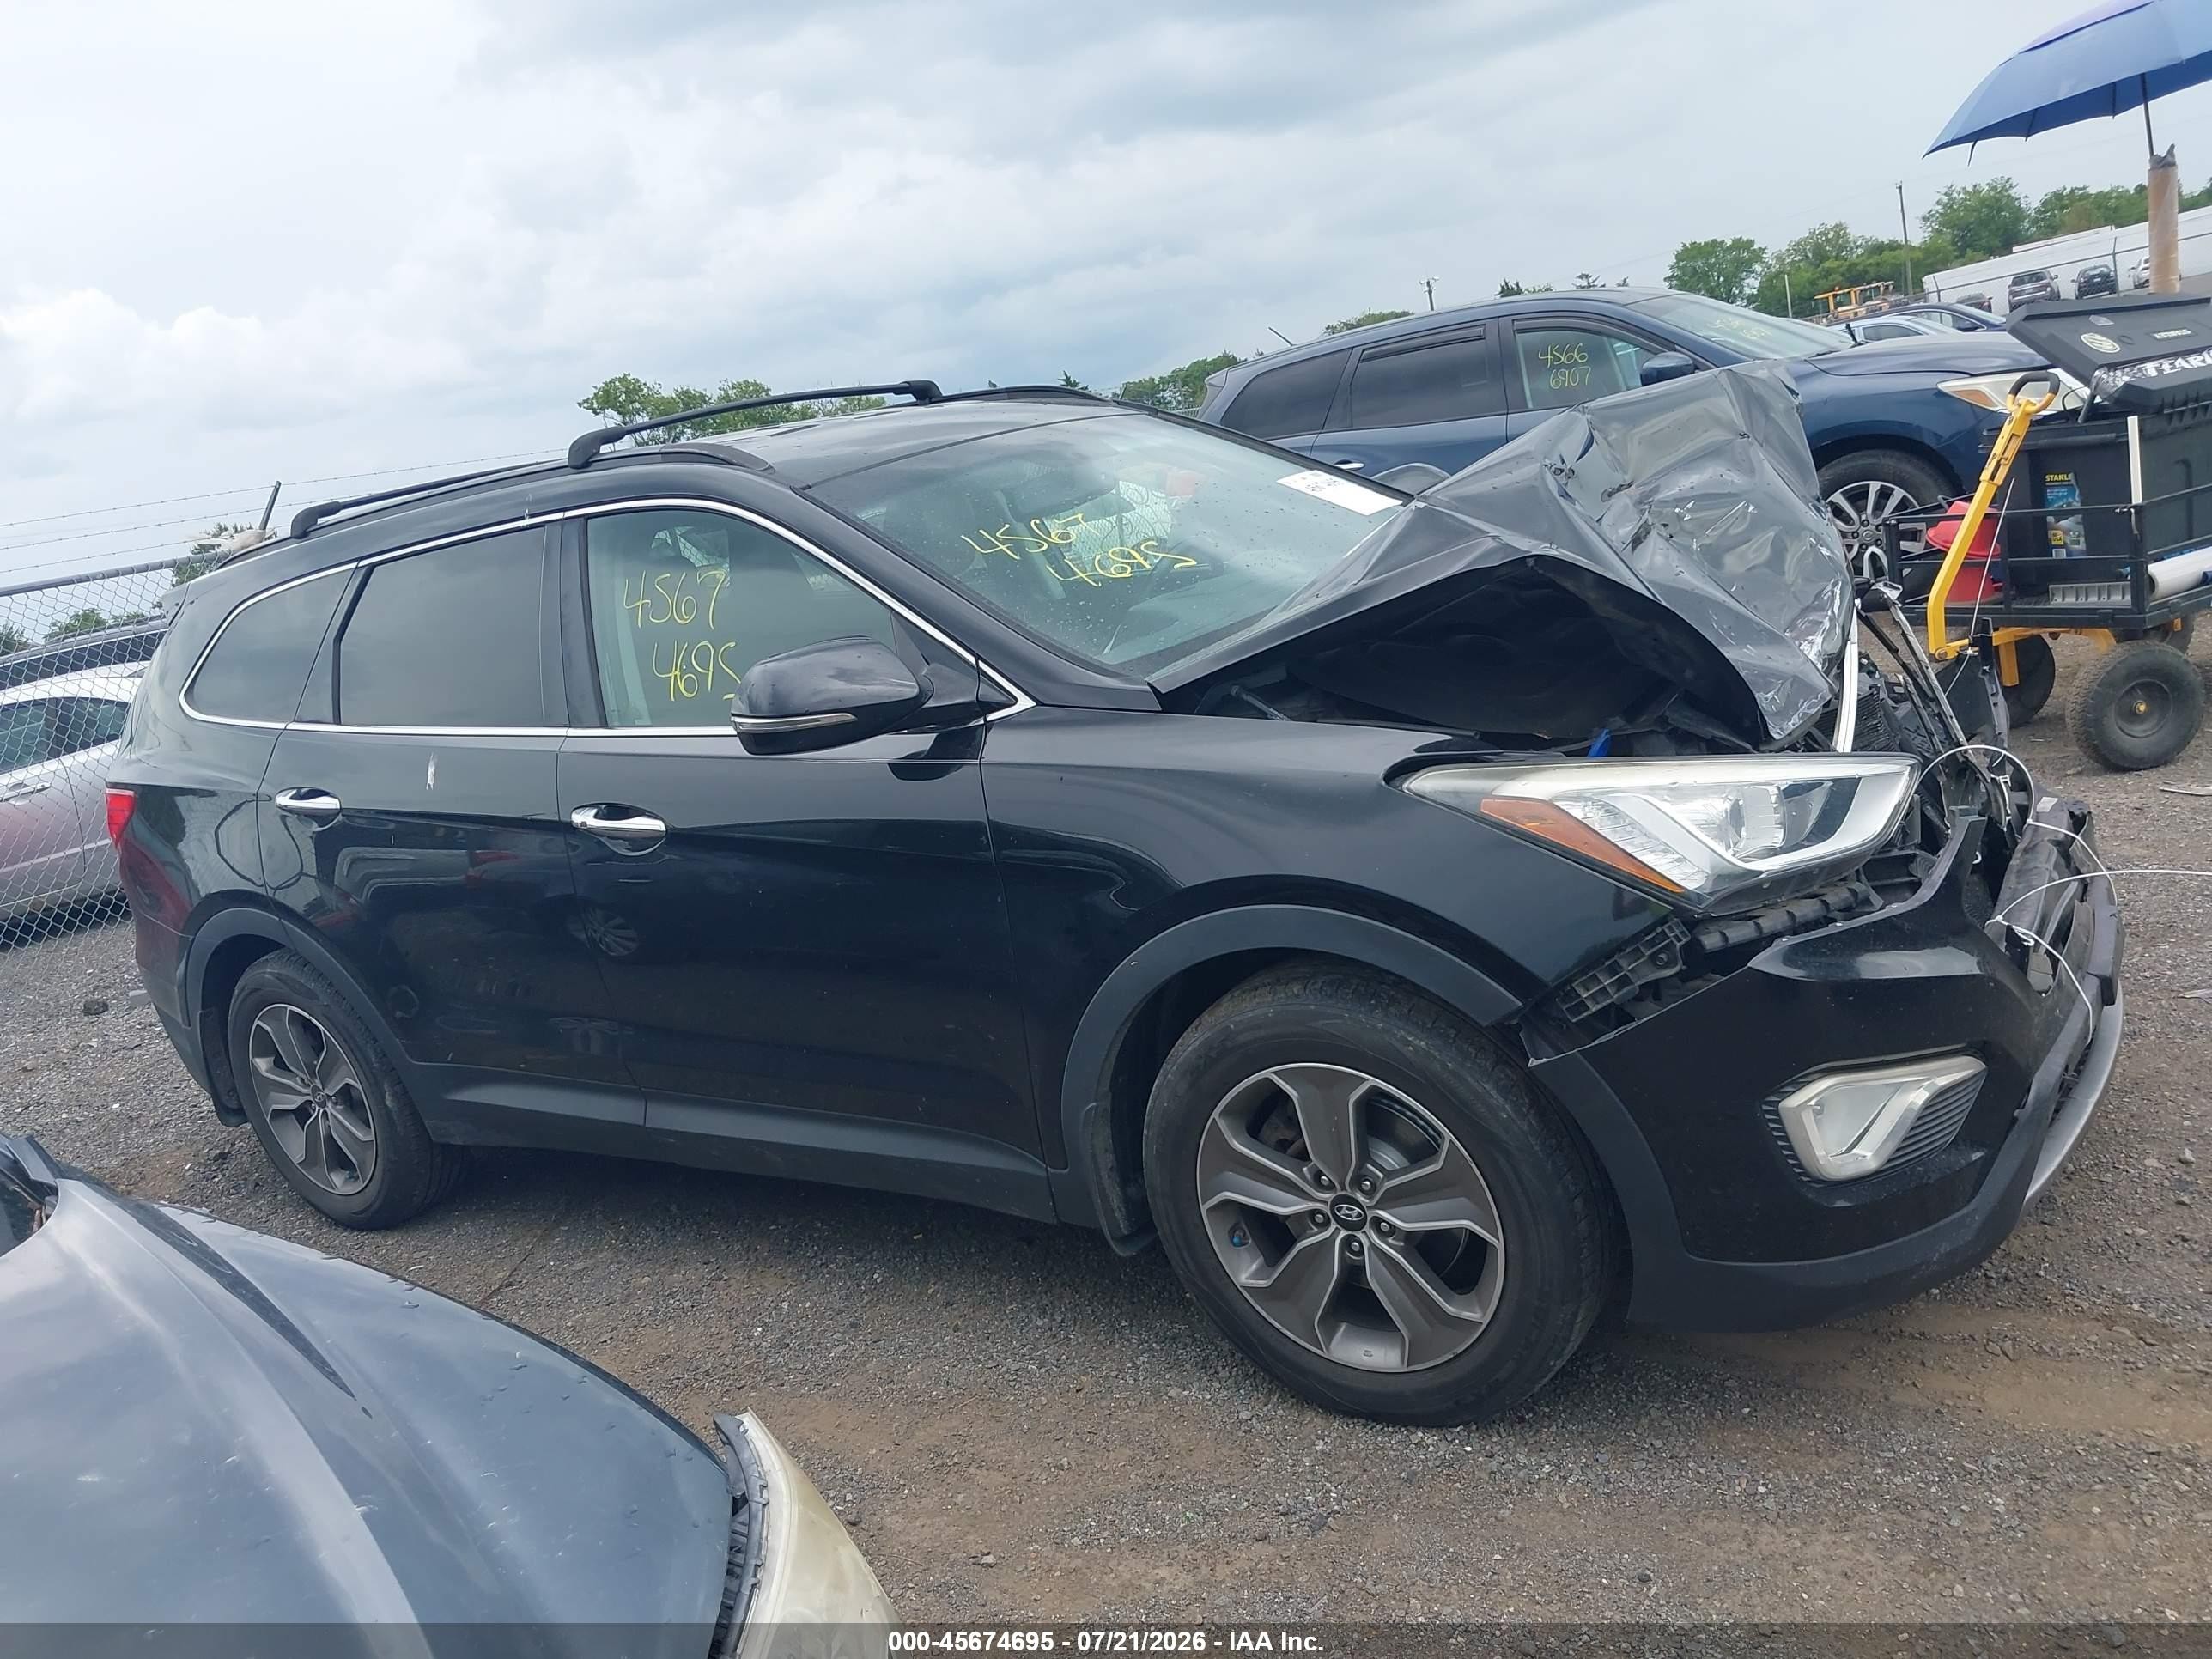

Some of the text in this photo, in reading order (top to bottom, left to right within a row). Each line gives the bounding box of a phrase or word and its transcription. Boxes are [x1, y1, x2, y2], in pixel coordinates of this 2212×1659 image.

[1538, 343, 1589, 369] 4566
[1549, 365, 1592, 390] 6907
[960, 513, 1100, 560] 4567
[1046, 540, 1197, 587] 4695
[623, 569, 726, 630] 4567
[652, 639, 743, 702] 4695
